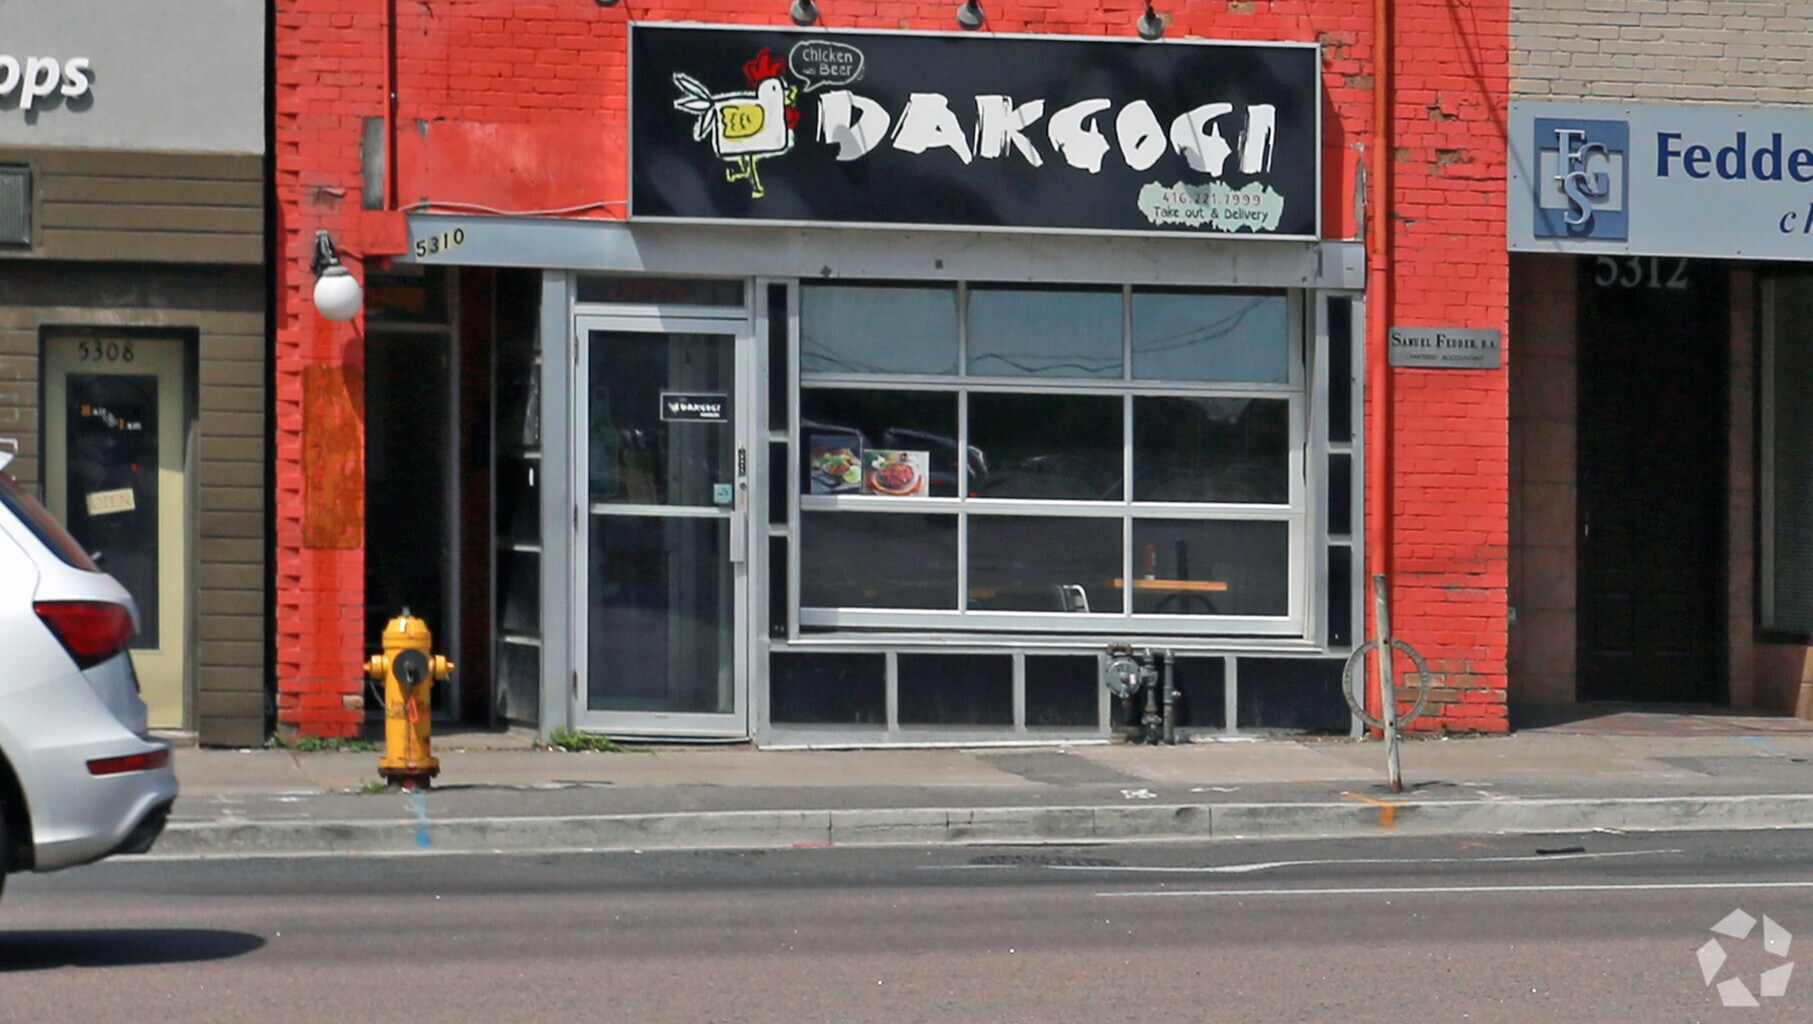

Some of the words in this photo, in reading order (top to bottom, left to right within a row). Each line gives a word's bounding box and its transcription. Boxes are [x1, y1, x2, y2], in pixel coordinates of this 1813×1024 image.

[820, 63, 852, 76] Beer
[1162, 193, 1261, 206] 416.221.7999
[1154, 206, 1179, 219] Take
[1185, 208, 1204, 219] out
[1211, 210, 1218, 219] &
[1225, 209, 1268, 223] Delivery
[416, 228, 465, 257] 5310
